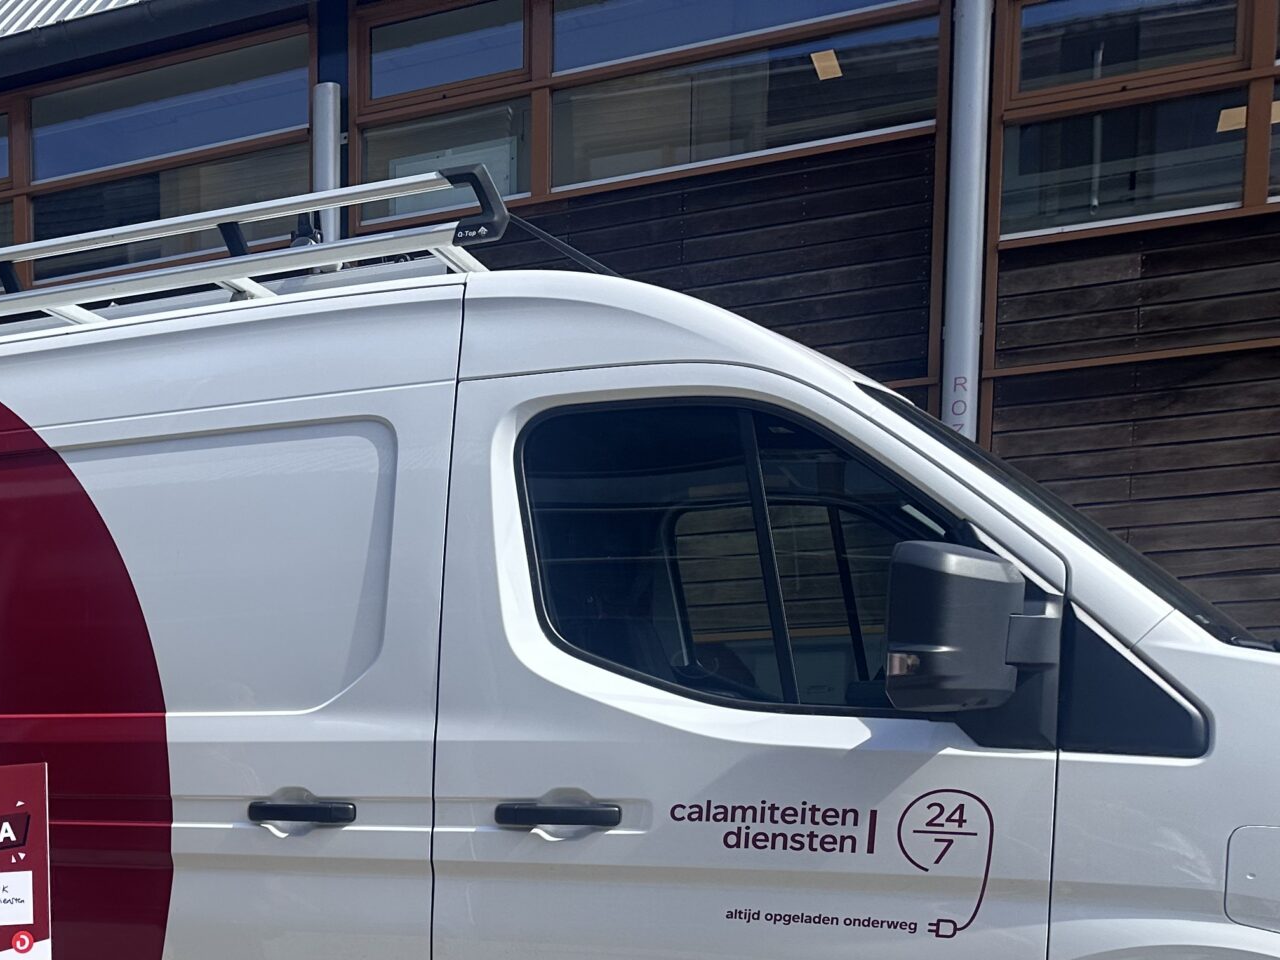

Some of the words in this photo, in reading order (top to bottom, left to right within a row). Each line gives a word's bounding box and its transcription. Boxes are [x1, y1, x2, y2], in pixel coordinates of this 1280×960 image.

[670, 800, 859, 827] calamiteiten
[925, 802, 967, 828] 24
[722, 826, 857, 853] diensten
[933, 838, 954, 865] 7
[725, 908, 761, 923] altijd
[764, 910, 839, 927] opgeladen
[843, 917, 918, 934] onderweg
